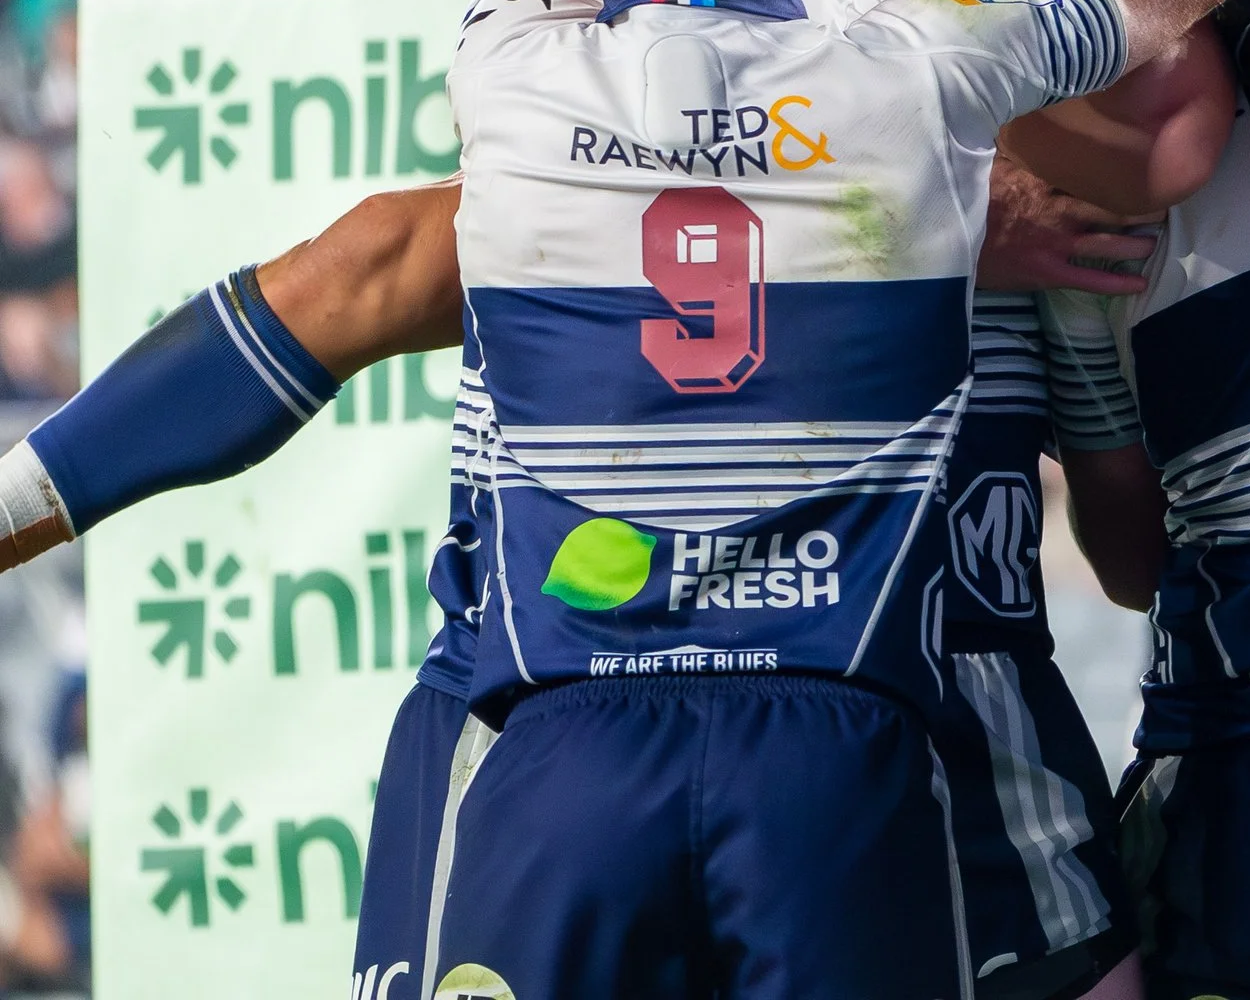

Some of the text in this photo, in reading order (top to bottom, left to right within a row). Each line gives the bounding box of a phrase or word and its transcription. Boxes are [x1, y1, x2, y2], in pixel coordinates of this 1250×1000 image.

[272, 38, 462, 182] nib
[681, 95, 837, 171] TED &
[570, 126, 769, 178] RAEWYN
[640, 186, 765, 394] 9
[672, 530, 840, 573] HELLO
[960, 485, 1037, 604] MG
[669, 571, 840, 611] FRESH
[590, 656, 621, 677] WE
[625, 655, 664, 675] ARE
[669, 653, 709, 673] THE
